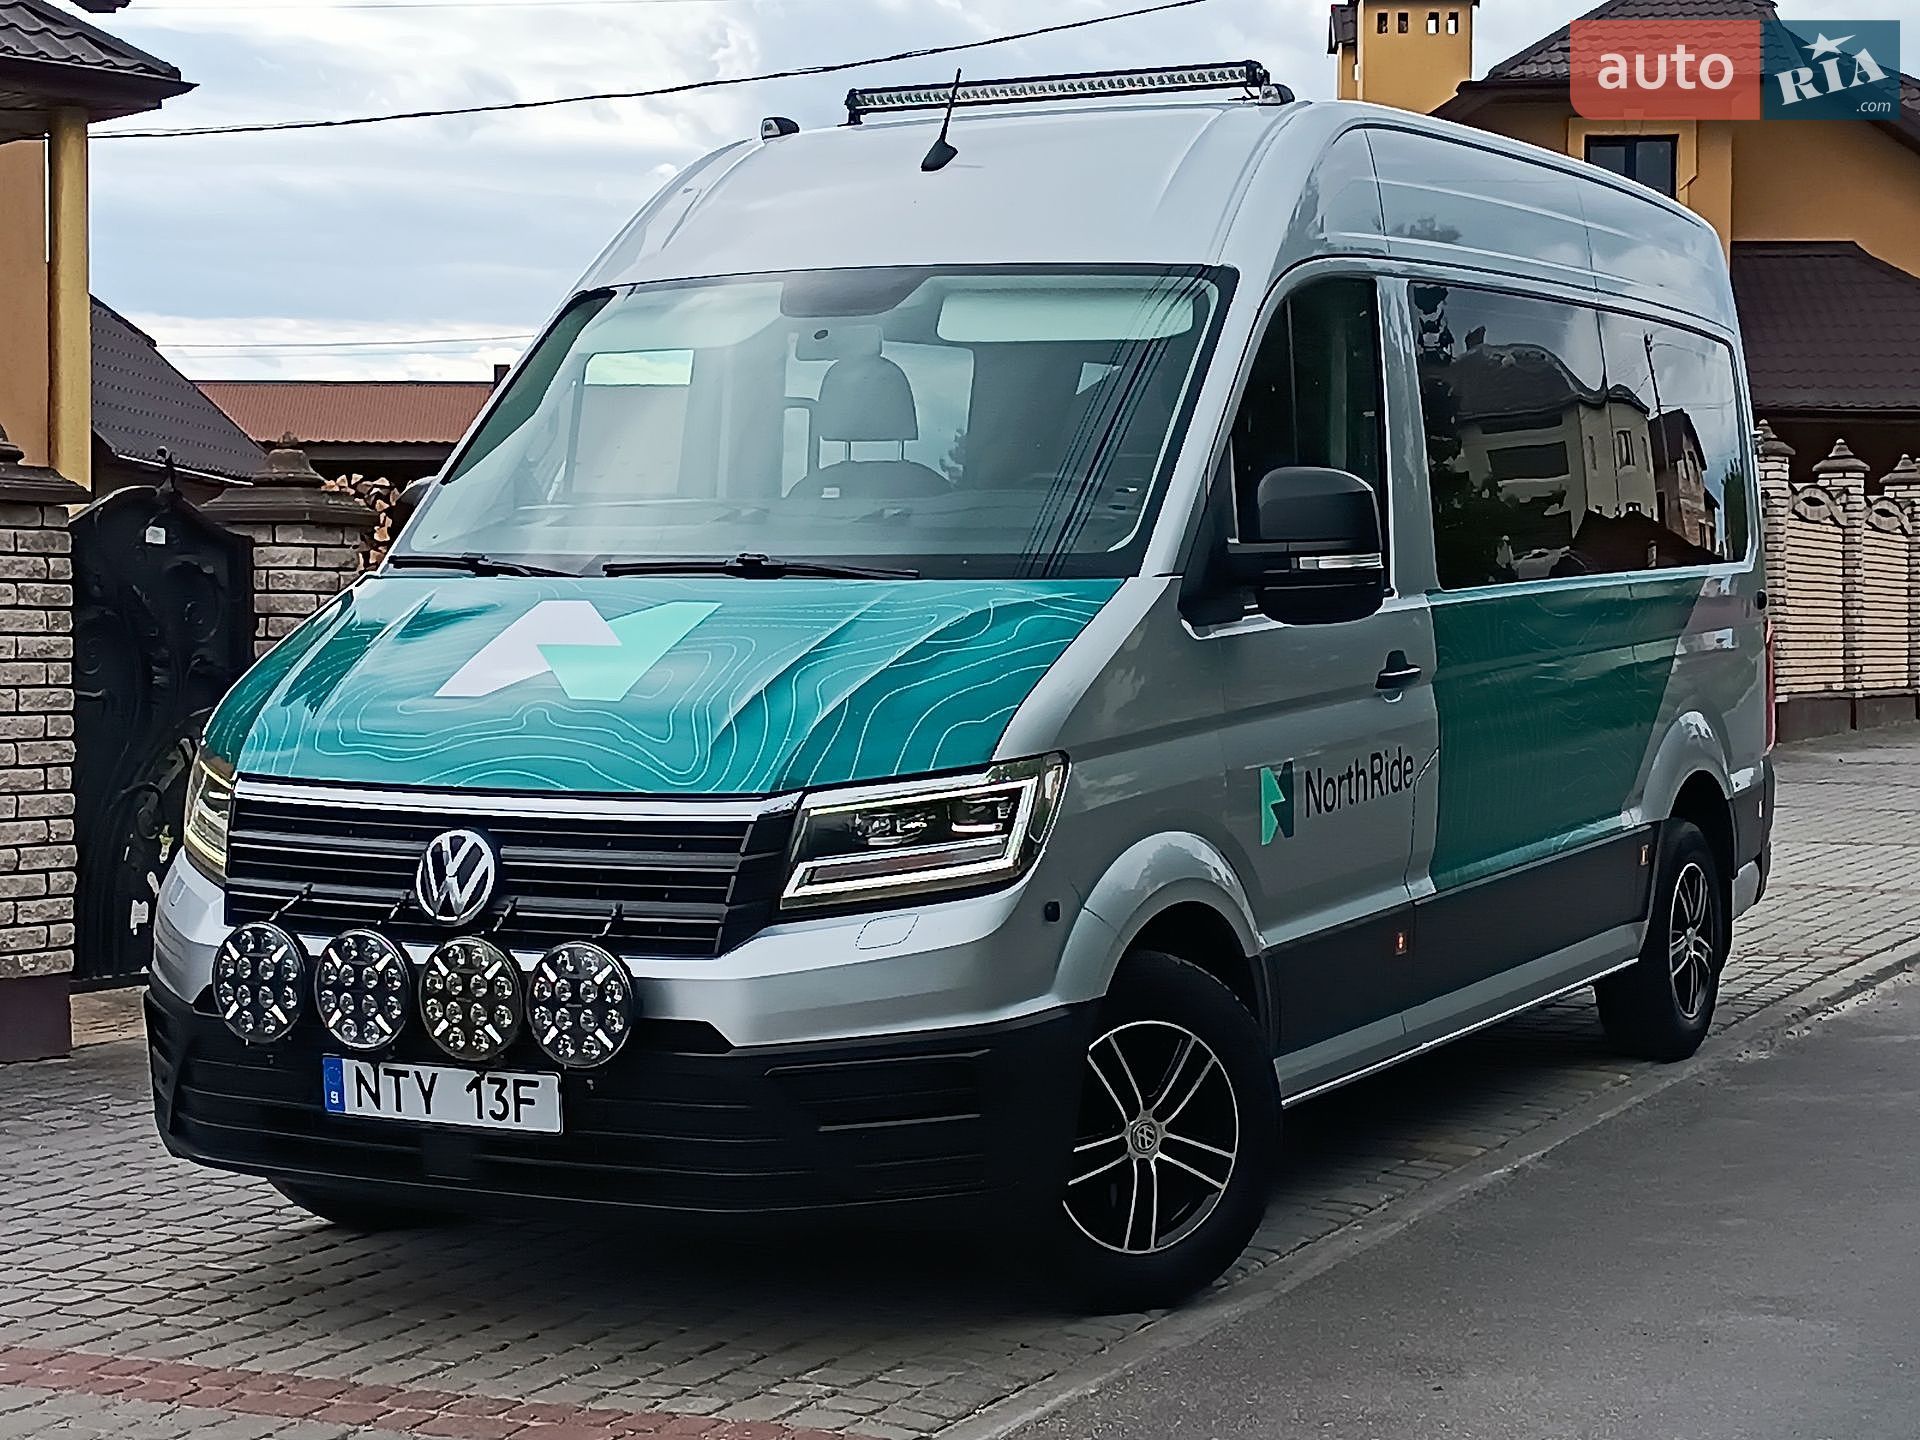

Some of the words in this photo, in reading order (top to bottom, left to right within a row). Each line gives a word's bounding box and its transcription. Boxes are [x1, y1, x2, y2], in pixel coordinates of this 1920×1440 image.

[1305, 745, 1414, 818] NorthRide
[355, 1065, 438, 1115] NTY
[466, 1074, 540, 1123] 13F
